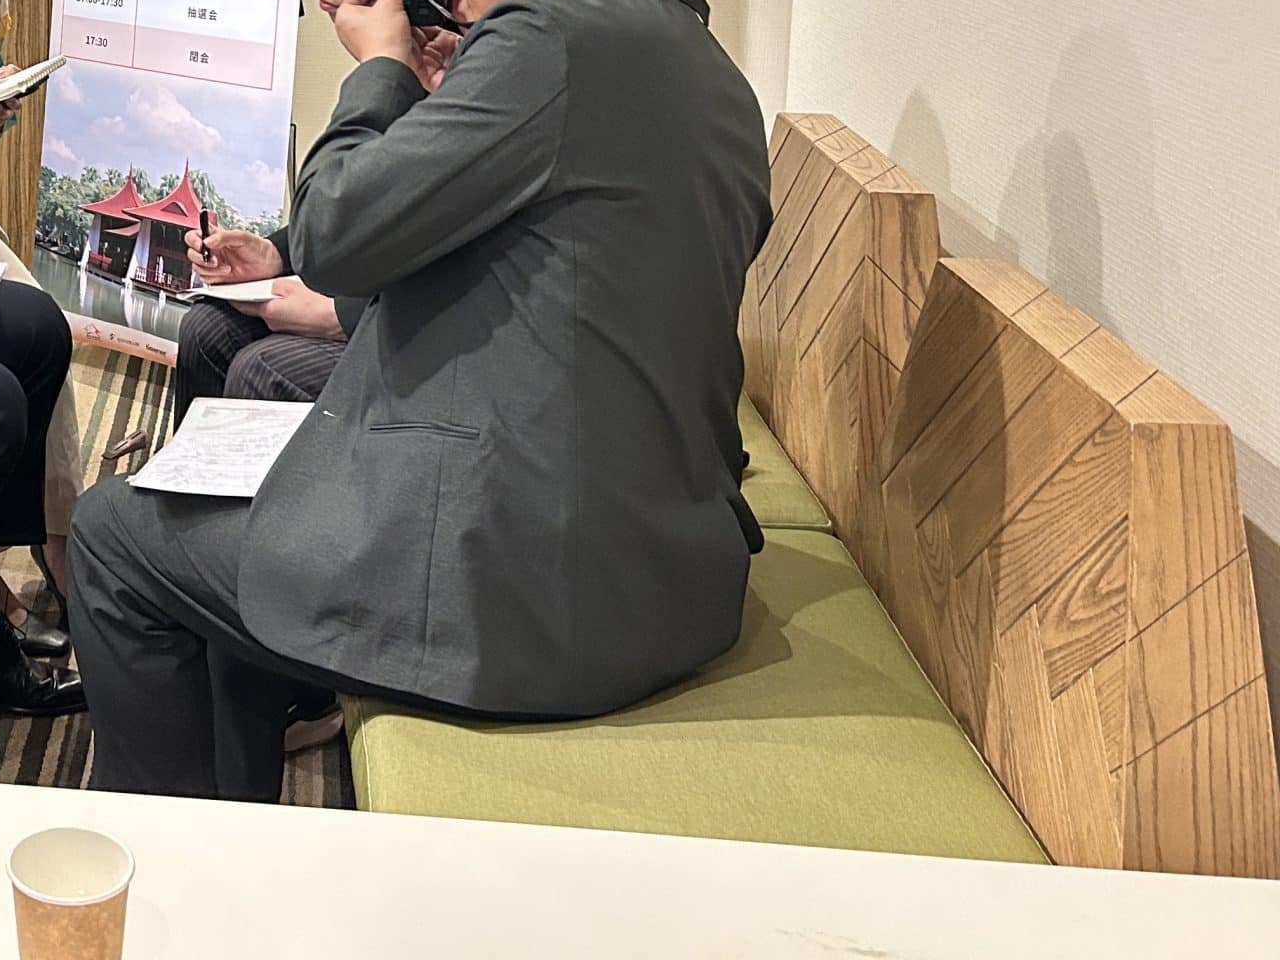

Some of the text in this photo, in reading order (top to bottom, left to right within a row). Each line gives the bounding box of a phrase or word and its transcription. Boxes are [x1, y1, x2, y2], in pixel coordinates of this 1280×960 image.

[187, 6, 218, 21] 抽選会
[85, 35, 108, 48] 17:30
[189, 50, 210, 64] 閉会
